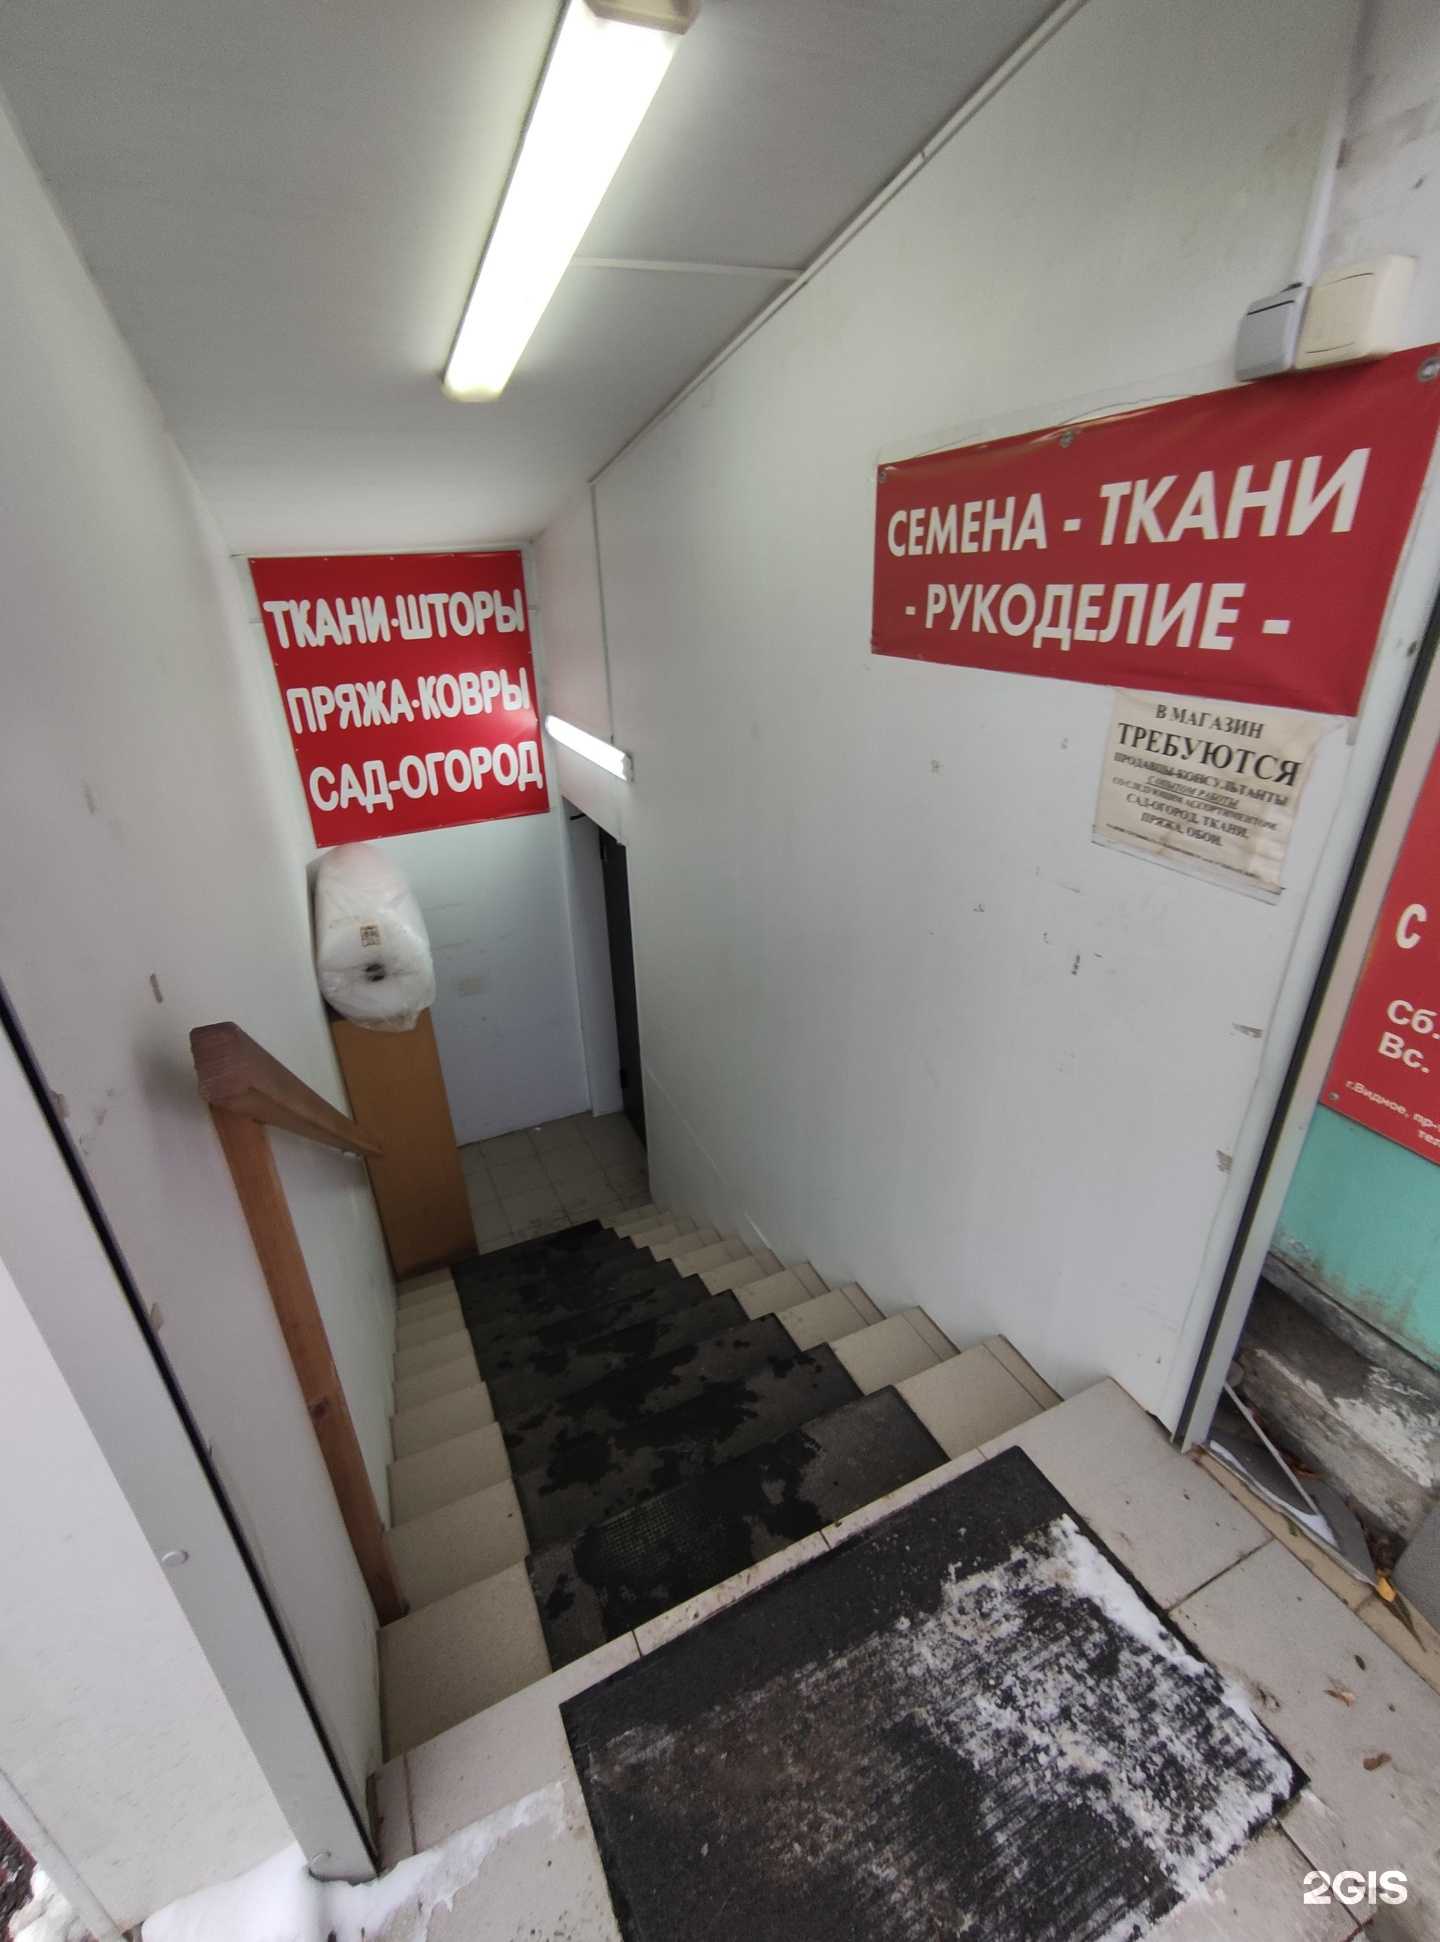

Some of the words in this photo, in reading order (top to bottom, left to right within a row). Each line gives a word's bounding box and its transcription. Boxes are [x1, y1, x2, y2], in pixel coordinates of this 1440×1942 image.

[887, 490, 1048, 557] СЕМЕНА
[1099, 446, 1373, 546] ТКАНИ
[924, 582, 1246, 652] РУКОДЕЛИЕ
[1118, 722, 1302, 787] ТРЕБУЮТСЯ
[1156, 704, 1168, 719] В
[1171, 708, 1264, 739] МАГАЗИН
[308, 740, 544, 815] САД-ОГОРОД
[1378, 1031, 1430, 1073] Вс.
